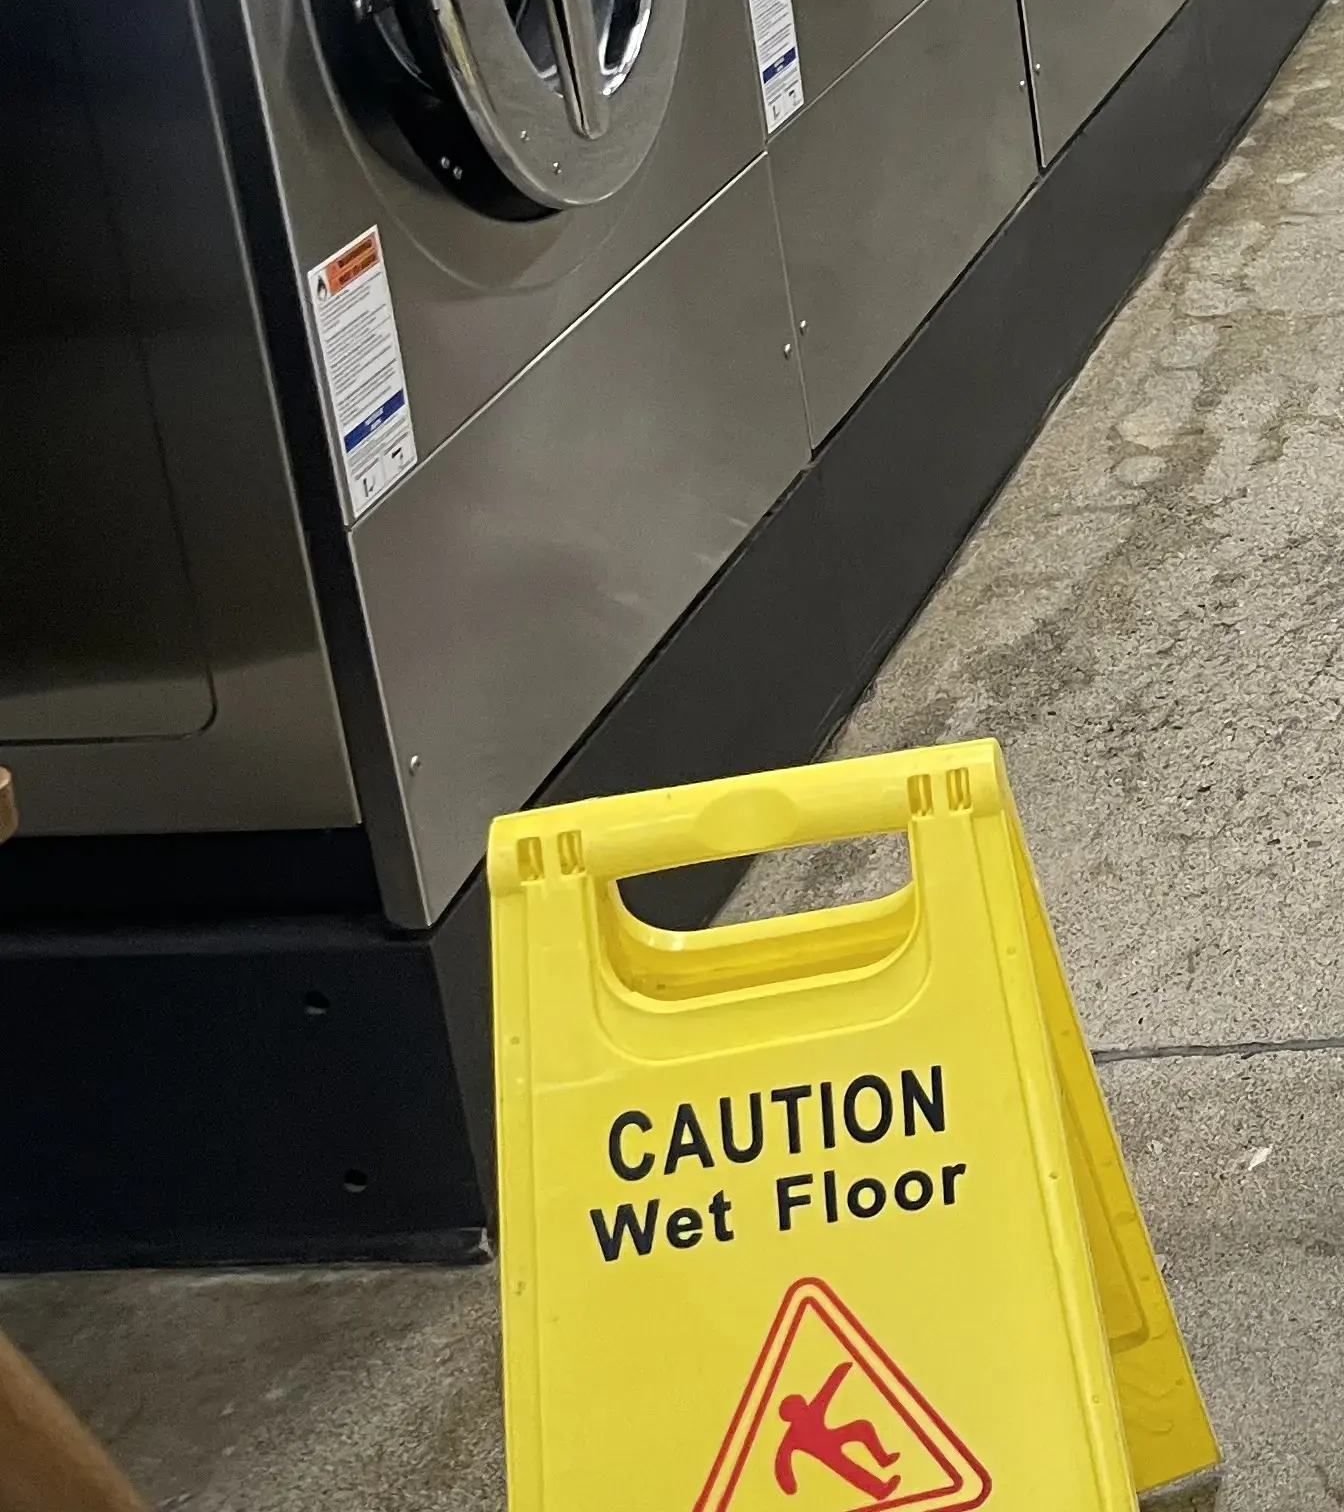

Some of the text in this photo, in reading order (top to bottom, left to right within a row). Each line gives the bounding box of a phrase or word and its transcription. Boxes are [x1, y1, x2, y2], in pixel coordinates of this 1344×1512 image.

[608, 1065, 946, 1182] CAUTION
[589, 1162, 967, 1263] Wet Floor
